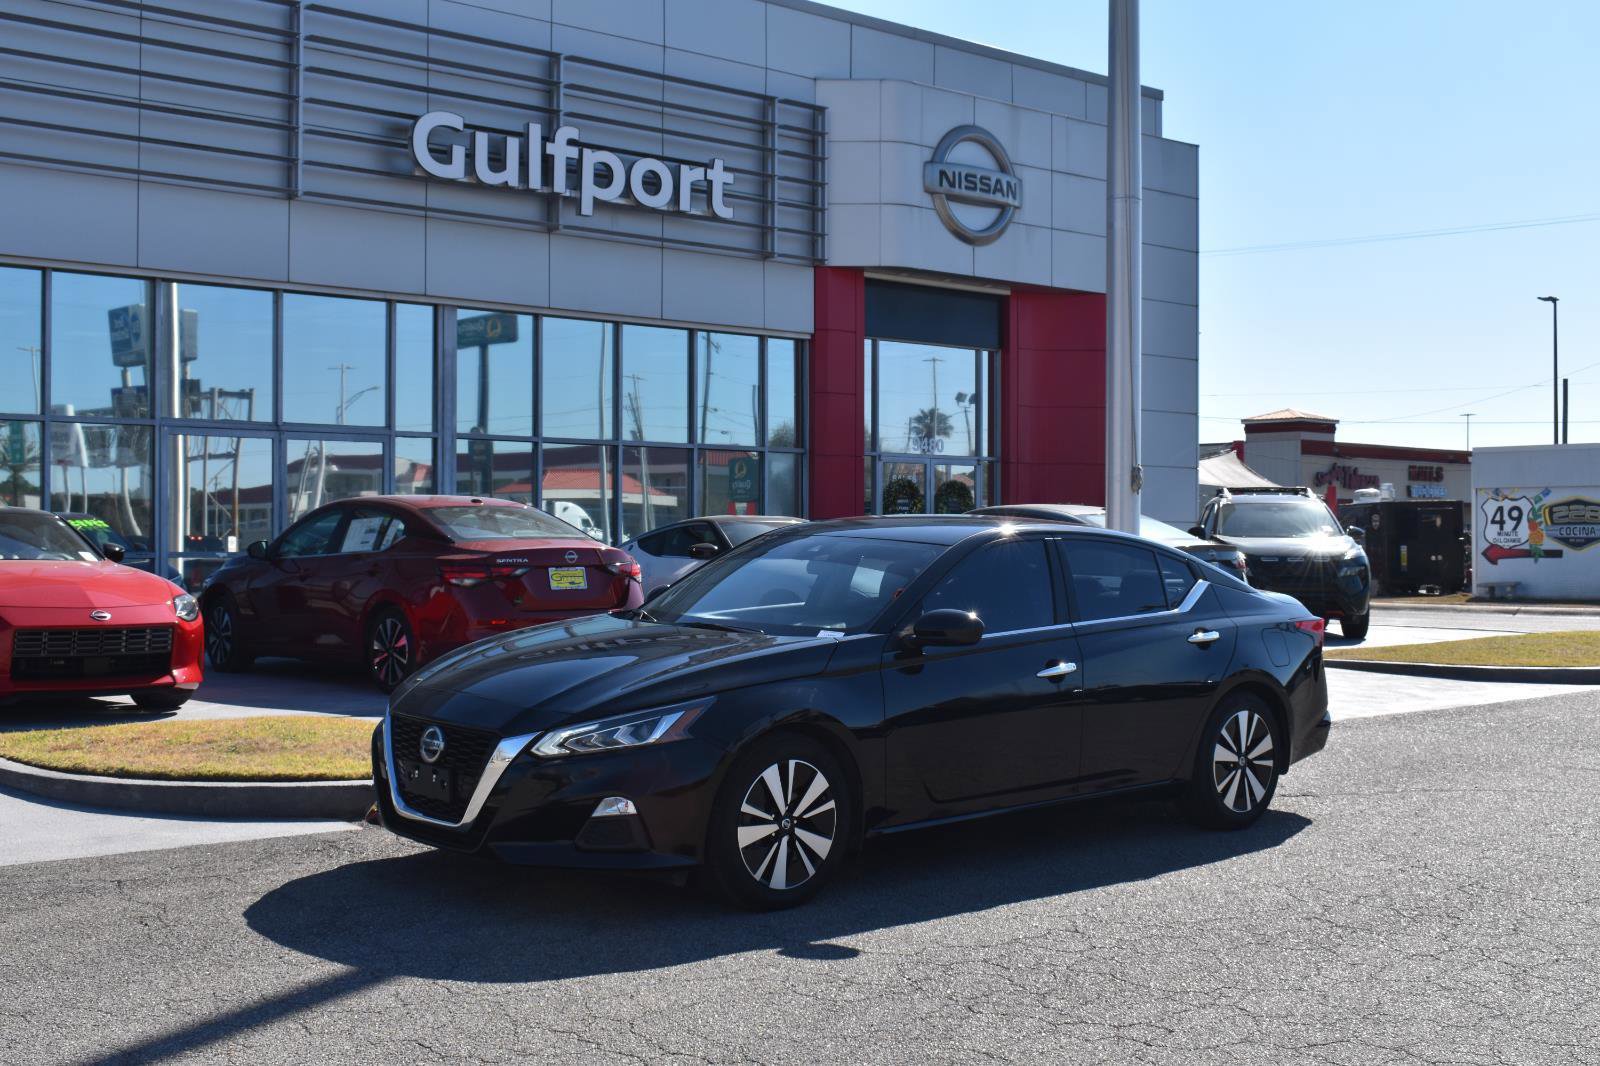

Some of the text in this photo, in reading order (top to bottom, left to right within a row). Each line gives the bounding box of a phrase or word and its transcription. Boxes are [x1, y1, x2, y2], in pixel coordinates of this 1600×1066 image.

[411, 111, 734, 218] Gulfport
[938, 168, 1017, 200] NISSAN
[911, 437, 945, 454] 9480
[1490, 505, 1524, 531] 49
[1558, 526, 1596, 537] COCINA
